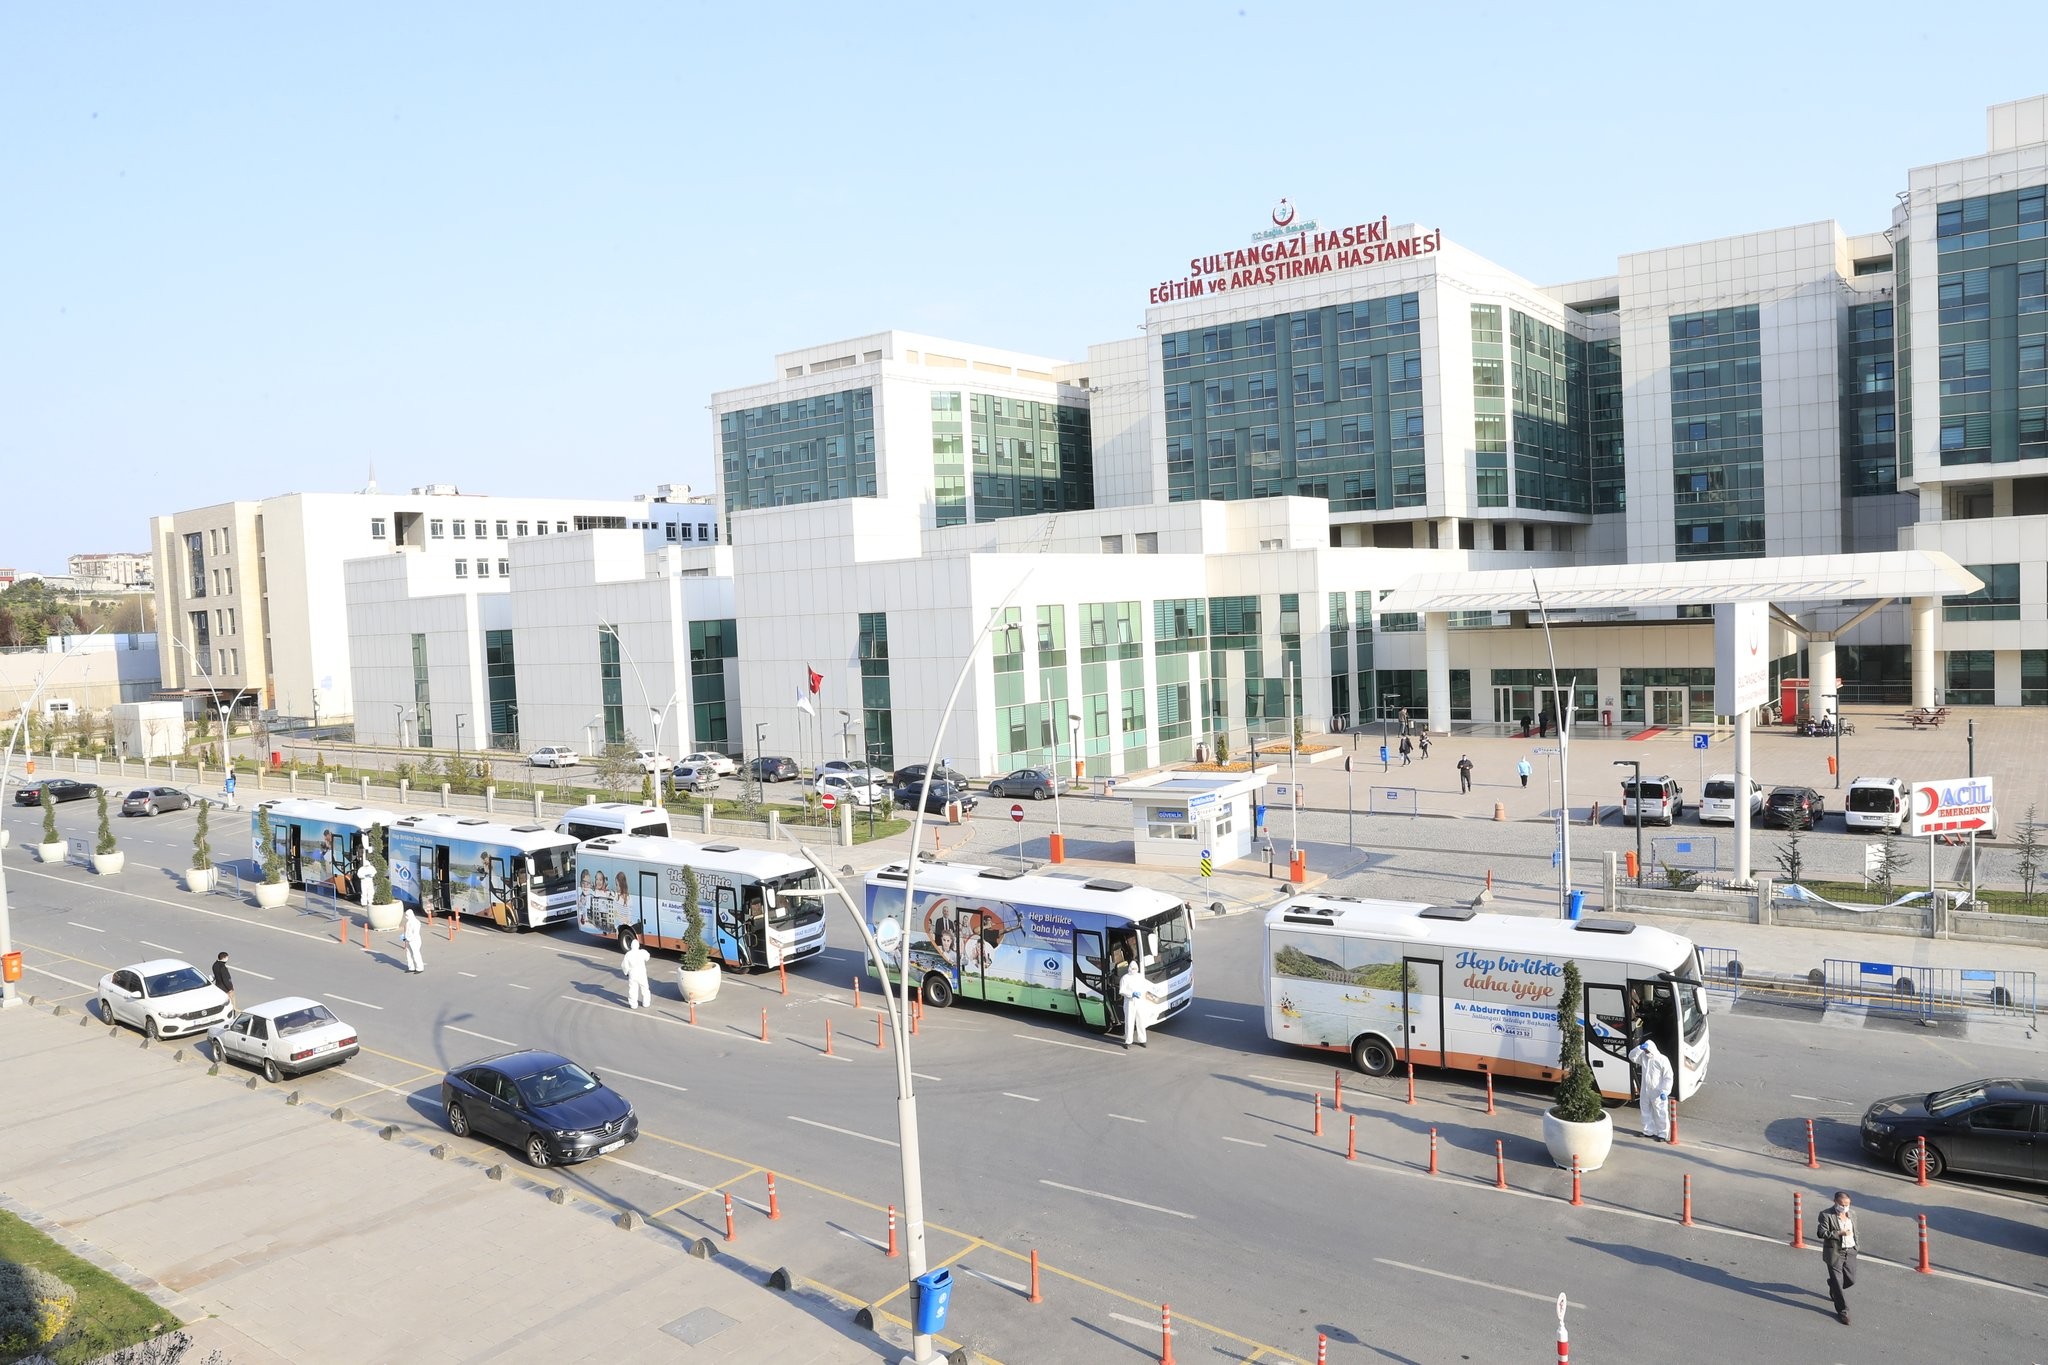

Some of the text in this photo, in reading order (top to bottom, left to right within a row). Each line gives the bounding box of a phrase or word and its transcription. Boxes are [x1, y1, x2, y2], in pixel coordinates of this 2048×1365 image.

[1190, 215, 1389, 277] SULTANGAZİ HASEKİ
[1150, 227, 1441, 304] EĞİTİM ve ARAŞTIRMA HASTANESİ
[1940, 781, 1992, 807] ACİL
[1938, 805, 1991, 818] EMERGENCY
[694, 872, 732, 887] Birlikte
[1028, 911, 1072, 925] Hep Birlikte
[1031, 923, 1070, 937] Daha İyiye
[1455, 951, 1562, 978] Hep birlikte
[1463, 973, 1555, 1001] daha iyiye
[1454, 1002, 1468, 1012] Av.
[1469, 1004, 1531, 1019] Abdurrahman
